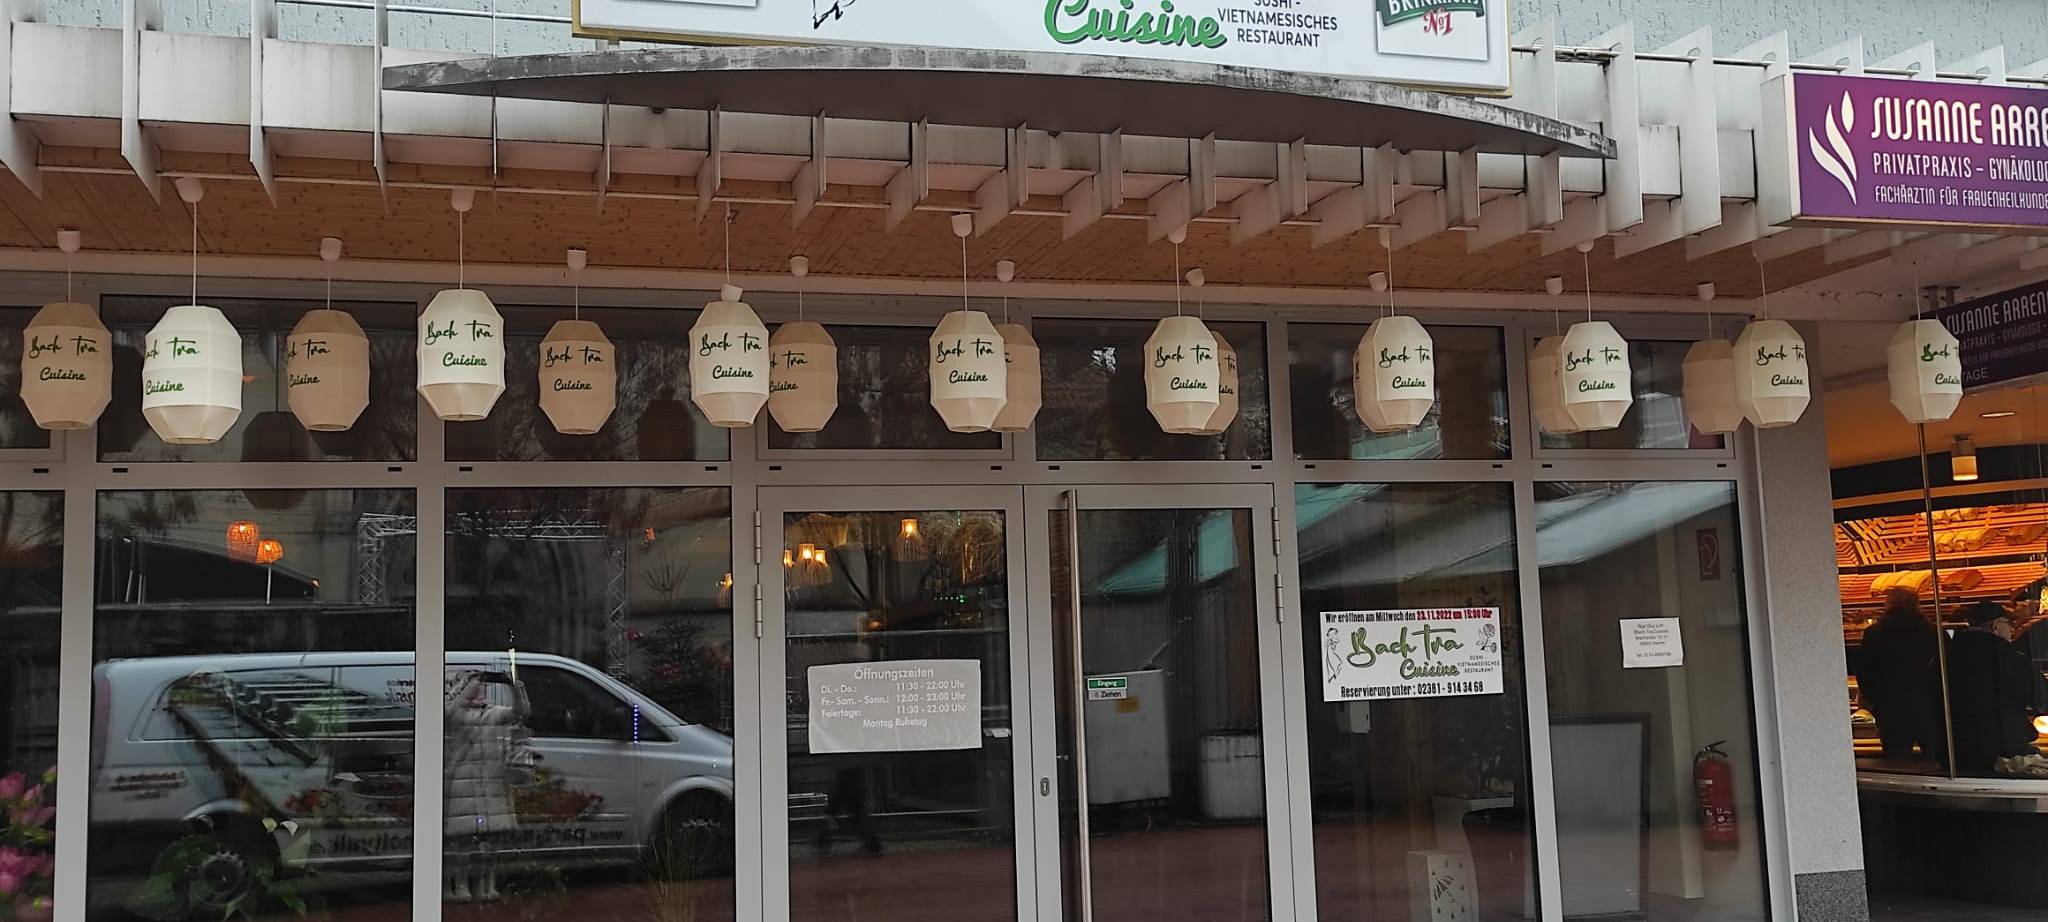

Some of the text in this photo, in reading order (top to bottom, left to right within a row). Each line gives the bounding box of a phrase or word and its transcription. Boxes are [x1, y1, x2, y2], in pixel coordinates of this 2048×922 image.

[1044, 0, 1227, 49] Cuisine
[1218, 8, 1338, 31] VIETNAMESISCHES
[1237, 28, 1320, 47] RESTAURANT
[1871, 97, 1984, 144] SUSANNE
[1873, 152, 1972, 178] PRIVATPRAXIS
[1875, 184, 1936, 205] FACHÄRZTIN
[1940, 187, 1959, 206] FÜR
[1946, 291, 2048, 335] SUSANNE ARREN
[425, 319, 494, 345] Bach Tra
[29, 335, 99, 358] Bach Tra
[167, 336, 200, 359] Tra
[301, 338, 330, 360] Tra
[700, 332, 762, 356] Bach Tra
[936, 337, 966, 363] Bach
[970, 337, 994, 360] Tra
[1756, 344, 1788, 366] Bach
[1921, 343, 1951, 361] Bach
[443, 352, 487, 367] Cuisine
[545, 345, 604, 368] Bach Tra
[780, 350, 808, 370] Tra
[1154, 344, 1212, 368] Bach Tra
[1379, 346, 1411, 368] Bach
[1565, 346, 1622, 371] Bach Tra
[40, 367, 87, 381] Cuisine
[712, 365, 754, 379] Cuisine
[949, 370, 989, 383] Cuisine
[1392, 376, 1427, 389] Cuisine
[146, 380, 184, 395] Cuisine
[554, 378, 592, 391] Cuisine
[1170, 377, 1208, 391] Cuisine
[1578, 380, 1616, 392] Cuisine
[1325, 608, 1493, 623] Wir eröffnen am Mittwoch den 23.11.2022 um 15:00 Uhr
[1347, 624, 1464, 668] Bach Tra
[1400, 658, 1461, 680] Cuisine
[896, 681, 918, 691] 11:30
[926, 681, 949, 690] 22:00
[951, 678, 966, 689] Uhr
[1341, 685, 1391, 698] Reservierung
[1391, 684, 1412, 696] unter
[1417, 682, 1441, 695] 02381
[1447, 682, 1461, 693] 914
[1463, 681, 1473, 693] 34
[1474, 681, 1484, 692] 68
[896, 693, 919, 703] 12:00
[926, 692, 949, 701] 23:00
[951, 690, 966, 700] Uhr
[896, 705, 919, 716] 11:30
[926, 703, 949, 713] 22:00
[863, 717, 928, 730] Montag Ruhetag
